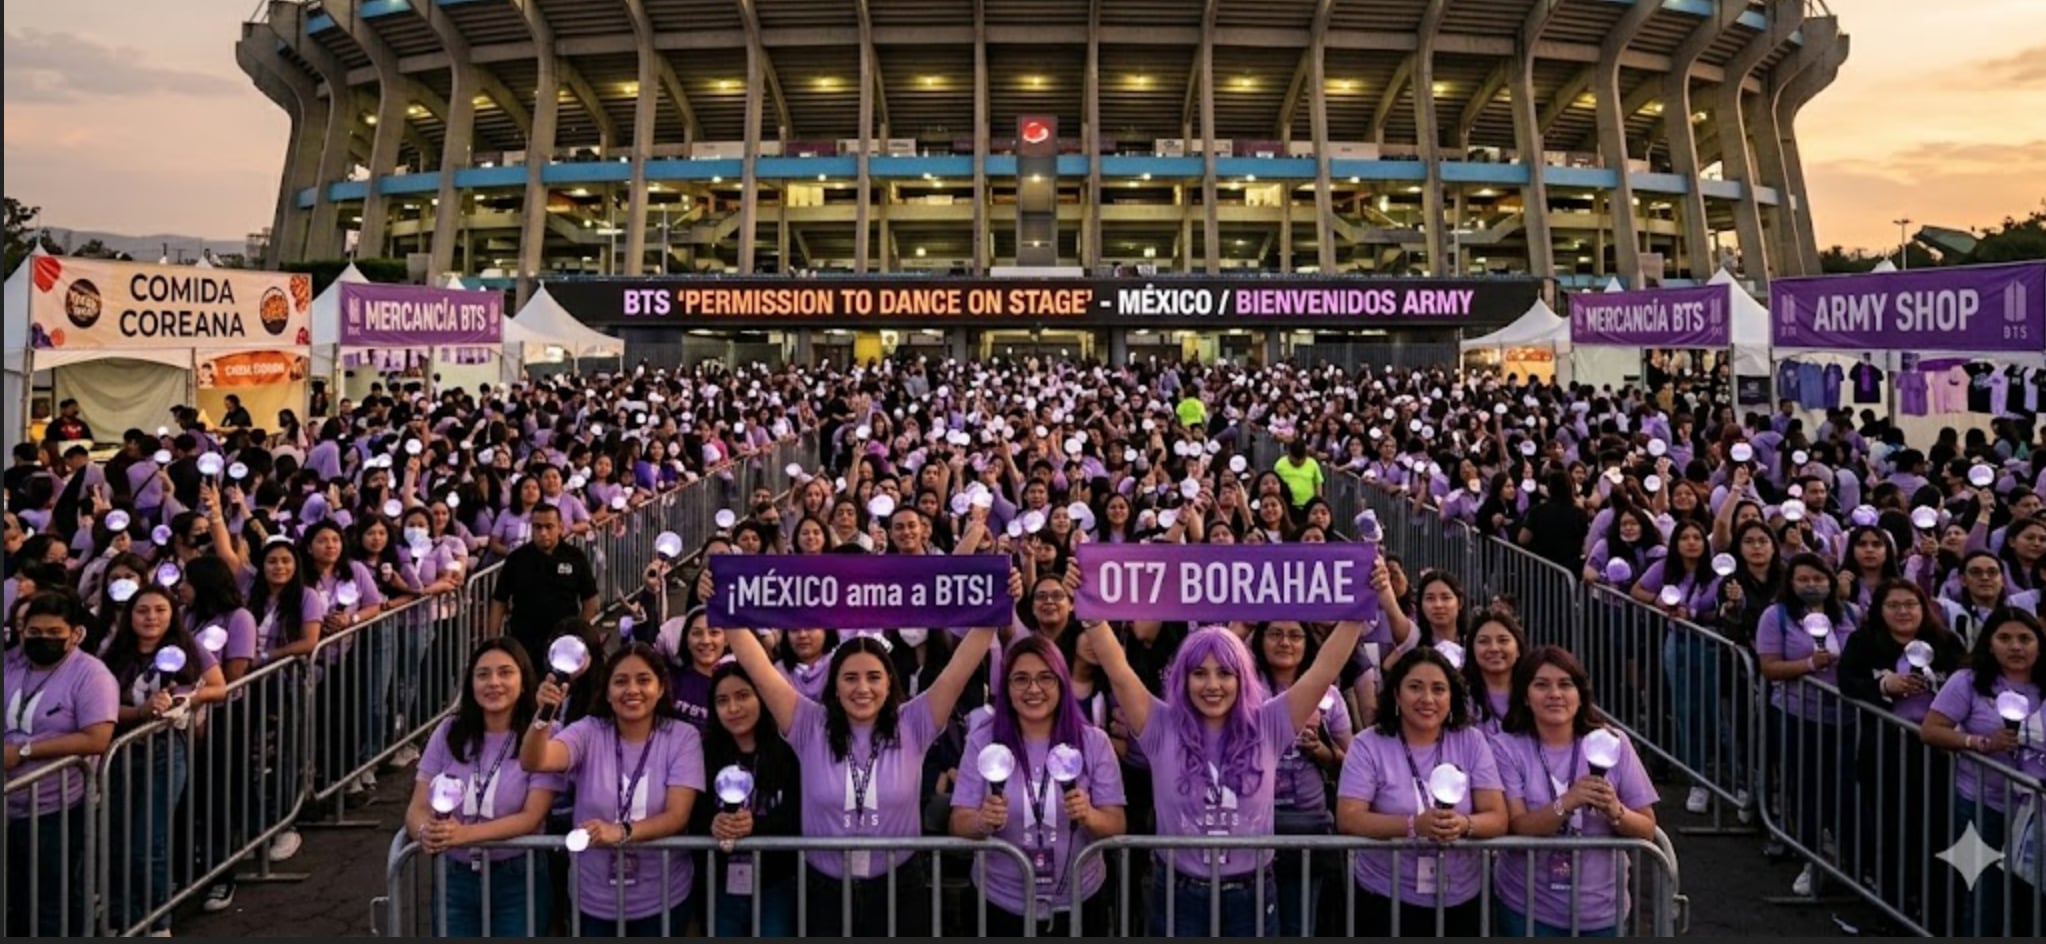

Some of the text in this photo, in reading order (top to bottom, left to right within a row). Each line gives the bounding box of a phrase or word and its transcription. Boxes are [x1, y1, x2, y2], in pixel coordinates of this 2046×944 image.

[130, 273, 235, 304] COMIDA
[624, 289, 671, 315] BTS
[840, 289, 872, 315] TO
[879, 289, 961, 315] DANCE
[968, 289, 1002, 315] ON
[1118, 284, 1213, 315] MÉXICO
[1217, 289, 1230, 315] /
[1236, 289, 1397, 315] BIENVENIDOS
[1402, 289, 1474, 315] ARMY
[119, 309, 245, 338] COREANA
[365, 297, 486, 331] MERCANCÍA BTS
[1585, 298, 1704, 333] MERCANCÍA BTS
[1813, 289, 1979, 332] ARMY SHOP
[2003, 325, 2028, 339] BTS
[728, 568, 993, 615] ¡MÉXICO ama a BTS!
[1099, 560, 1354, 604] OT7 BORAHAE
